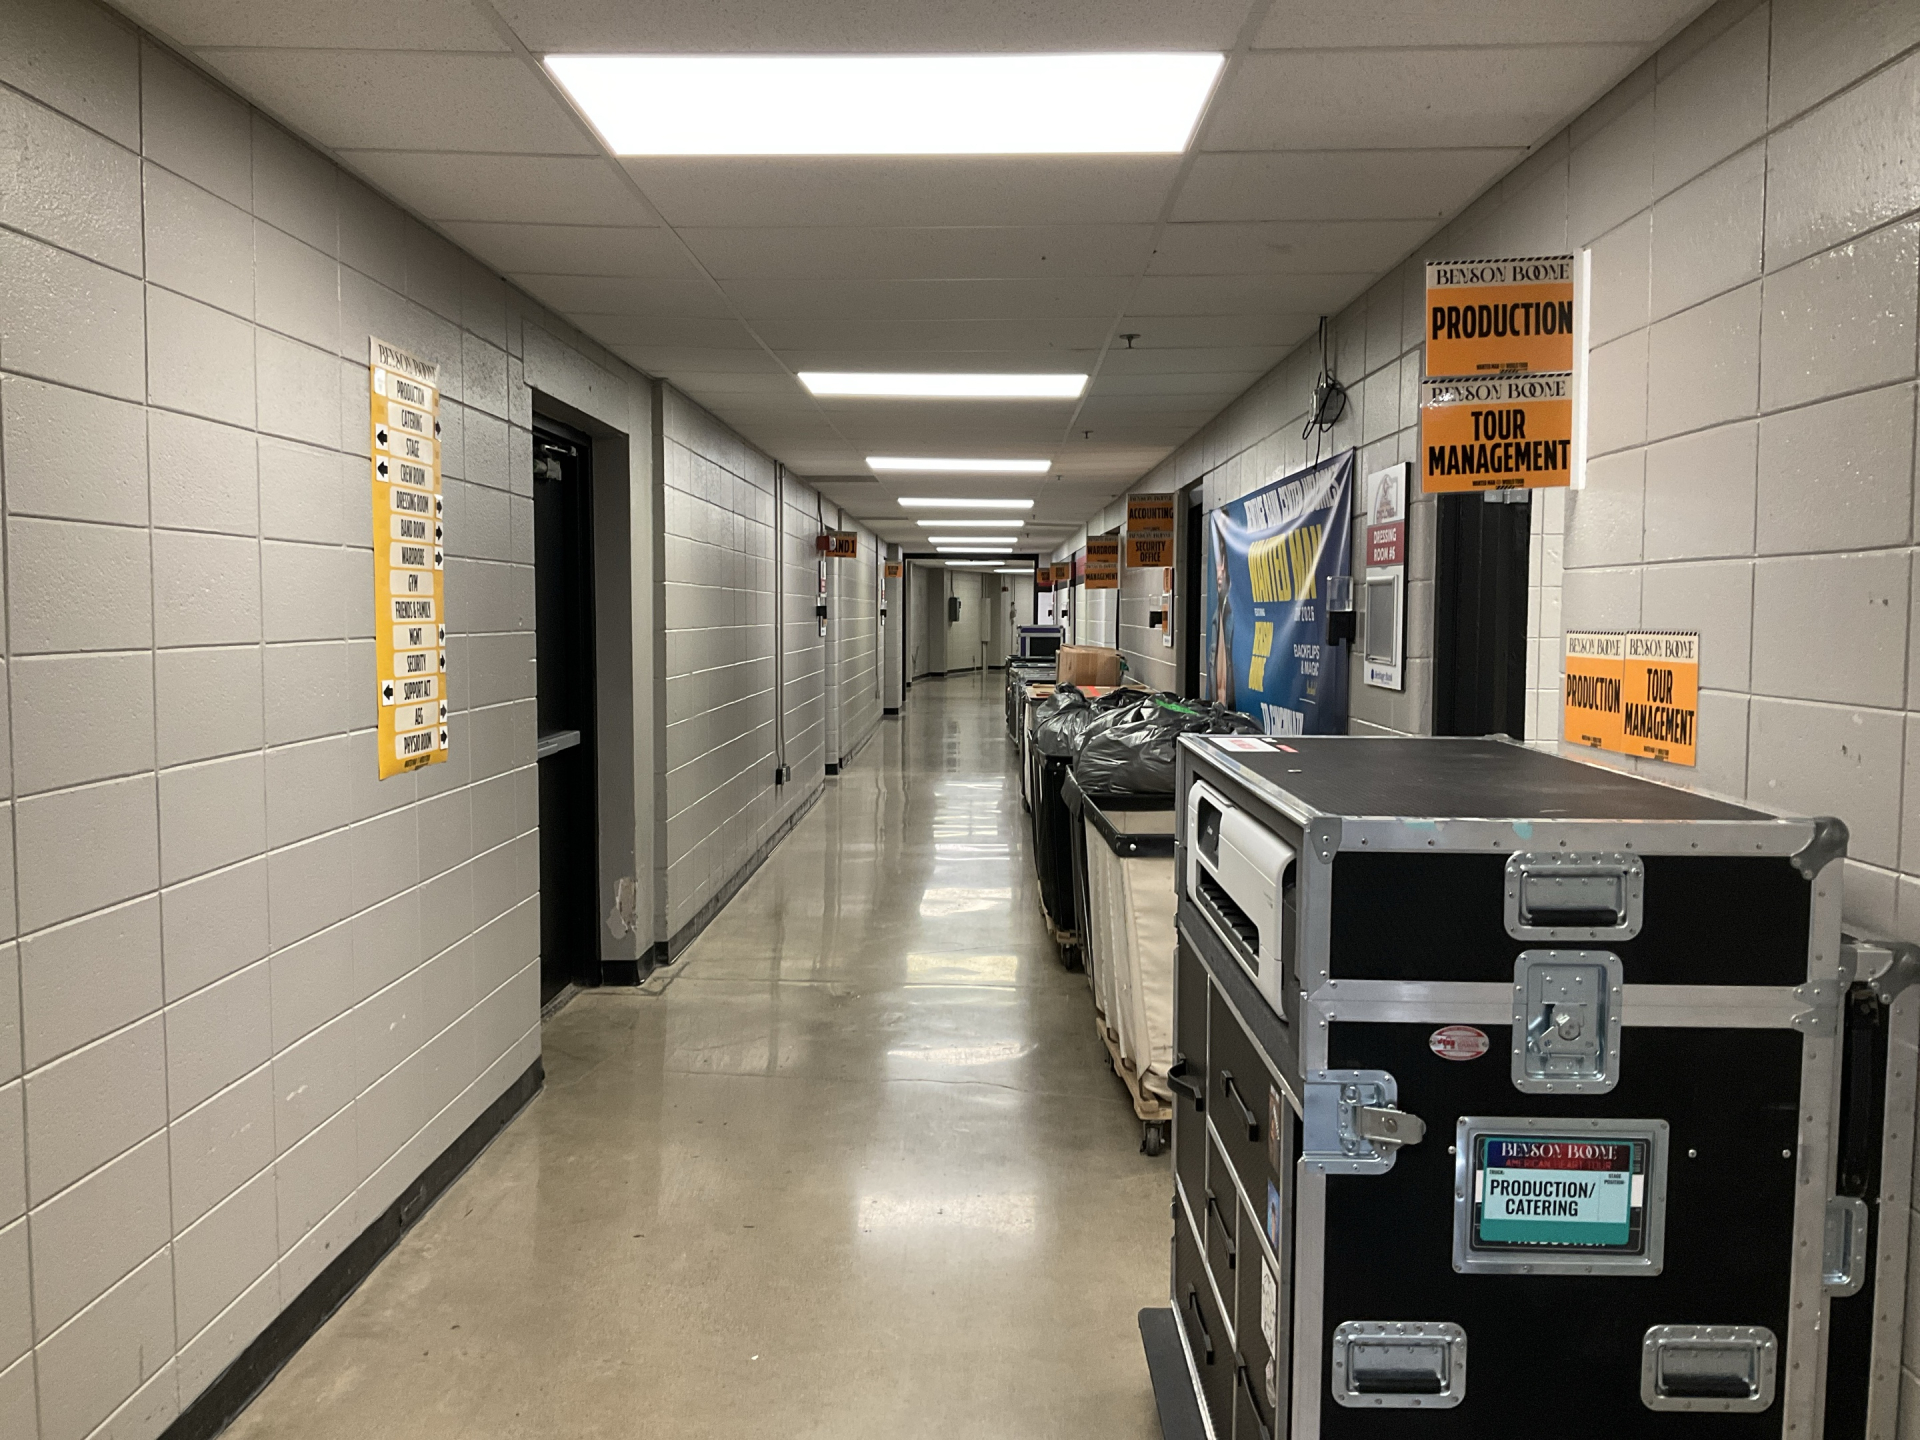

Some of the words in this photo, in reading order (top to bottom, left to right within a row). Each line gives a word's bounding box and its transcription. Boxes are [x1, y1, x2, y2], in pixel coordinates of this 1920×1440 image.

[1436, 265, 1506, 286] BENSON
[1512, 263, 1570, 282] BOONE
[1432, 300, 1573, 340] PRODUCTION
[397, 379, 425, 407] PRODUCTION
[1508, 380, 1565, 399] BOONE
[401, 409, 423, 433] CATERING
[1471, 409, 1526, 441] TOUR
[406, 438, 420, 459] STAGE
[1428, 440, 1571, 476] MANAGEMENT
[401, 464, 413, 483] CREW
[413, 466, 426, 486] ROOM
[396, 490, 416, 511] DRESSING
[417, 494, 429, 513] ROOM
[1129, 507, 1173, 519] ACCOUNTING
[401, 518, 413, 537] BAND
[413, 520, 426, 539] ROOM
[1373, 528, 1396, 544] DRESSING
[402, 546, 424, 566] WARDROBE
[1087, 545, 1118, 555] WARDROBE
[1136, 541, 1166, 552] SECURITY
[1374, 547, 1388, 561] ROOM
[1140, 552, 1161, 562] OFFICE
[1248, 533, 1292, 602] WANTED
[1288, 523, 1322, 601] MAN
[408, 574, 418, 592] GYM
[1086, 572, 1118, 580] MANAGEMENT
[395, 601, 412, 619] FRIENDS
[417, 601, 431, 618] FAMILY
[1293, 643, 1320, 660] BACKFLIPS
[1569, 637, 1595, 655] BENSON
[1597, 638, 1621, 656] BOONE
[1629, 638, 1662, 657] BENSON
[1665, 640, 1694, 659] BOONE
[407, 653, 426, 673] SECURITY
[1304, 661, 1320, 677] MAGIC
[404, 681, 423, 700] SUPPORT
[1566, 673, 1621, 714] PRODUCTION
[1646, 668, 1673, 704] TOUR
[415, 707, 423, 725] AEG
[1624, 702, 1695, 746] MANAGEMENT
[404, 734, 420, 754] PHYSIO
[420, 731, 432, 752] ROOM
[1502, 1142, 1562, 1158] BENSON
[1568, 1144, 1618, 1160] BOONE
[1505, 1158, 1550, 1168] AMERICAN
[1490, 1179, 1596, 1198] PRODUCTION/
[1505, 1198, 1578, 1217] CATERING
